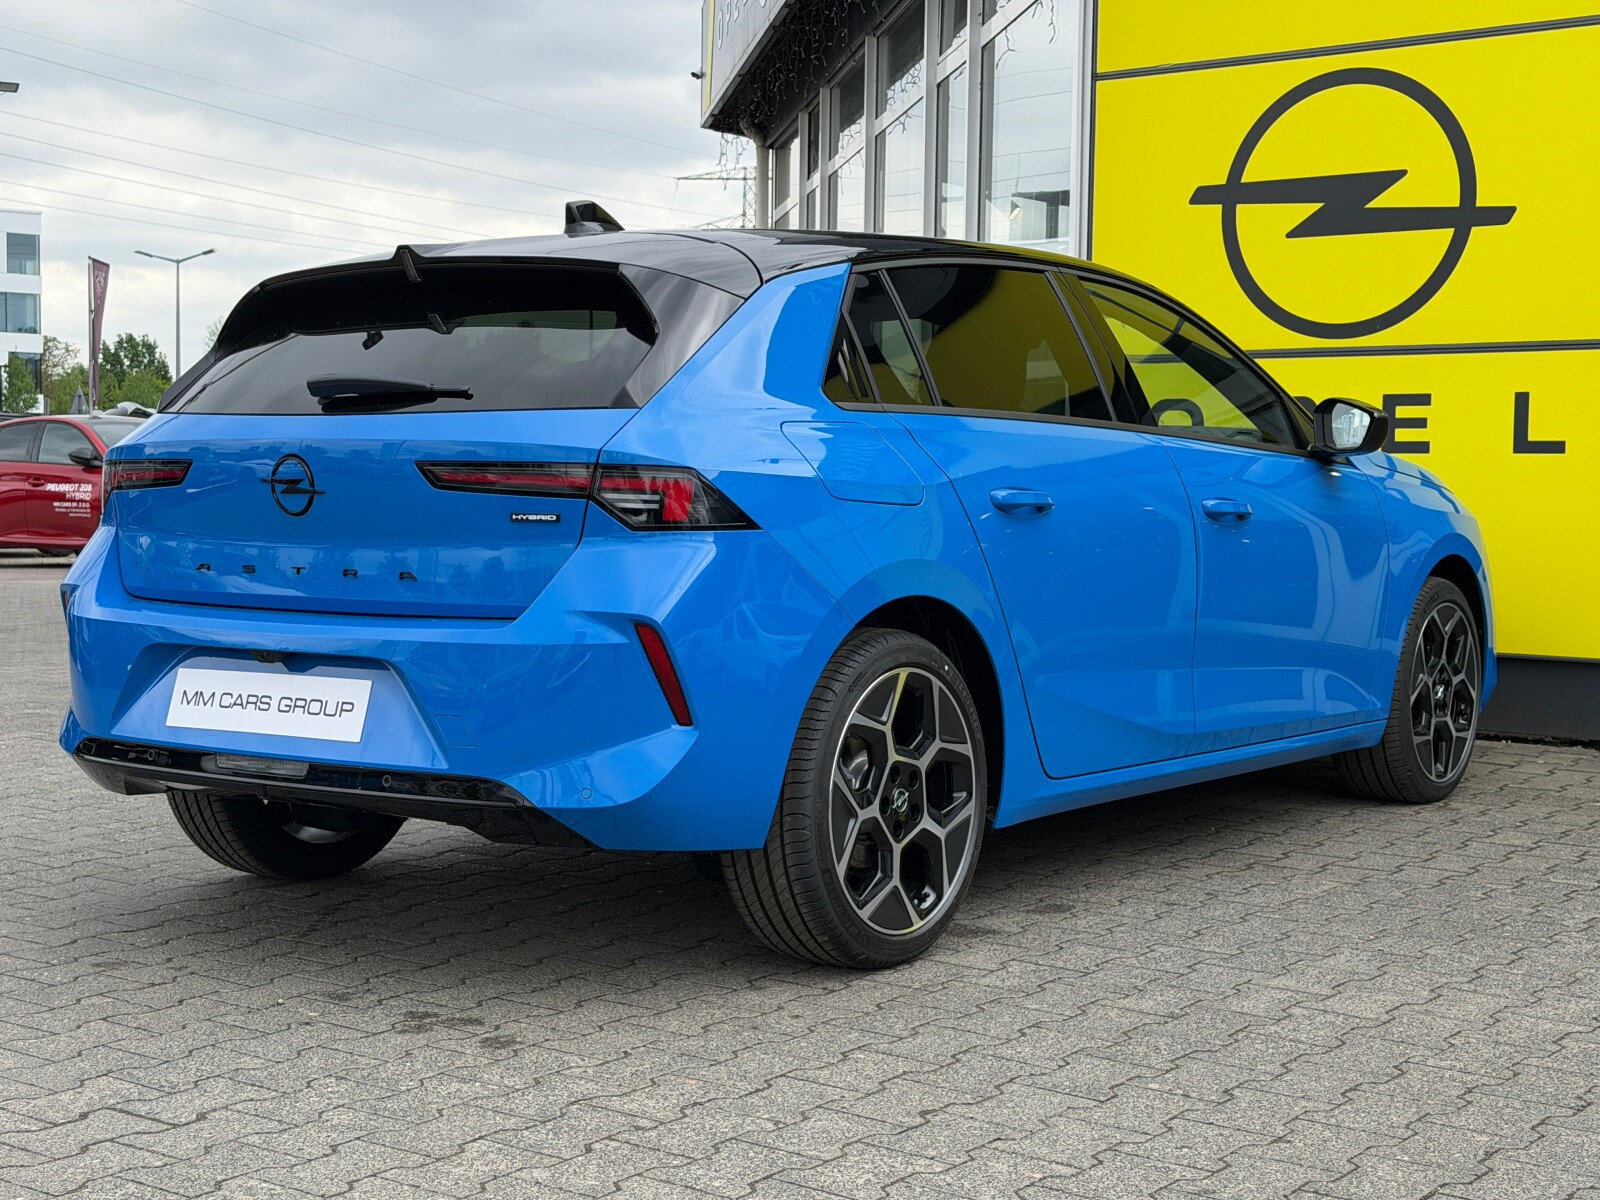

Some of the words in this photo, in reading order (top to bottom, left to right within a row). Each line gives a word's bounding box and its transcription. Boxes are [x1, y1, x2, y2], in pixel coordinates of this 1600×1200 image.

[1150, 391, 1566, 455] OEL
[47, 483, 79, 492] PEUGEOT
[80, 483, 92, 492] 208
[66, 492, 91, 500] HYBRID
[197, 563, 418, 582] ASTRA
[180, 690, 216, 708] MM
[218, 692, 273, 712] CARS
[277, 696, 355, 718] GROUP
